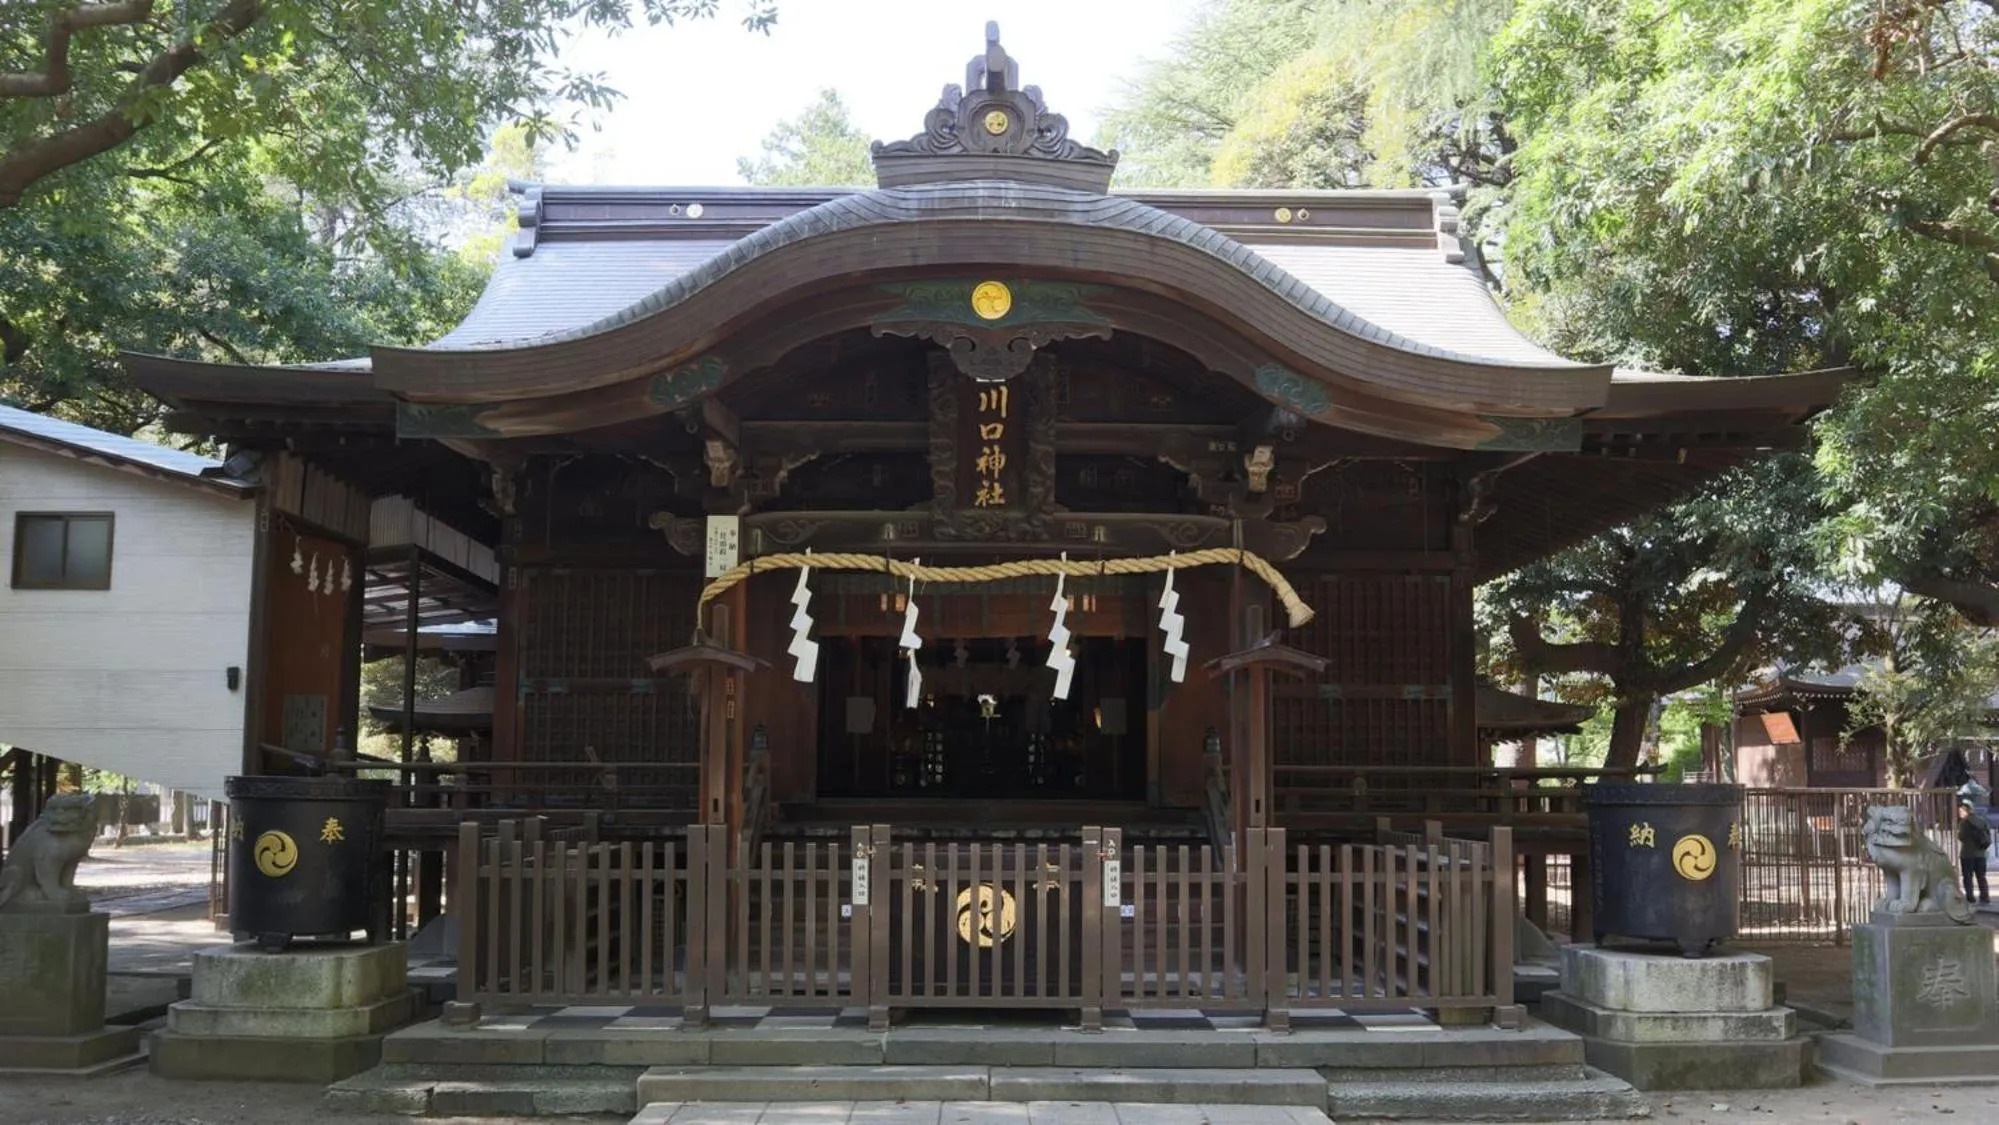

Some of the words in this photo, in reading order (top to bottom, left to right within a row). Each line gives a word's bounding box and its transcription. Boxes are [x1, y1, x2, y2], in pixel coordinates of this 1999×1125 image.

[975, 385, 1008, 507] 川口神社
[319, 816, 345, 844] 奉
[1628, 821, 1655, 848] 納
